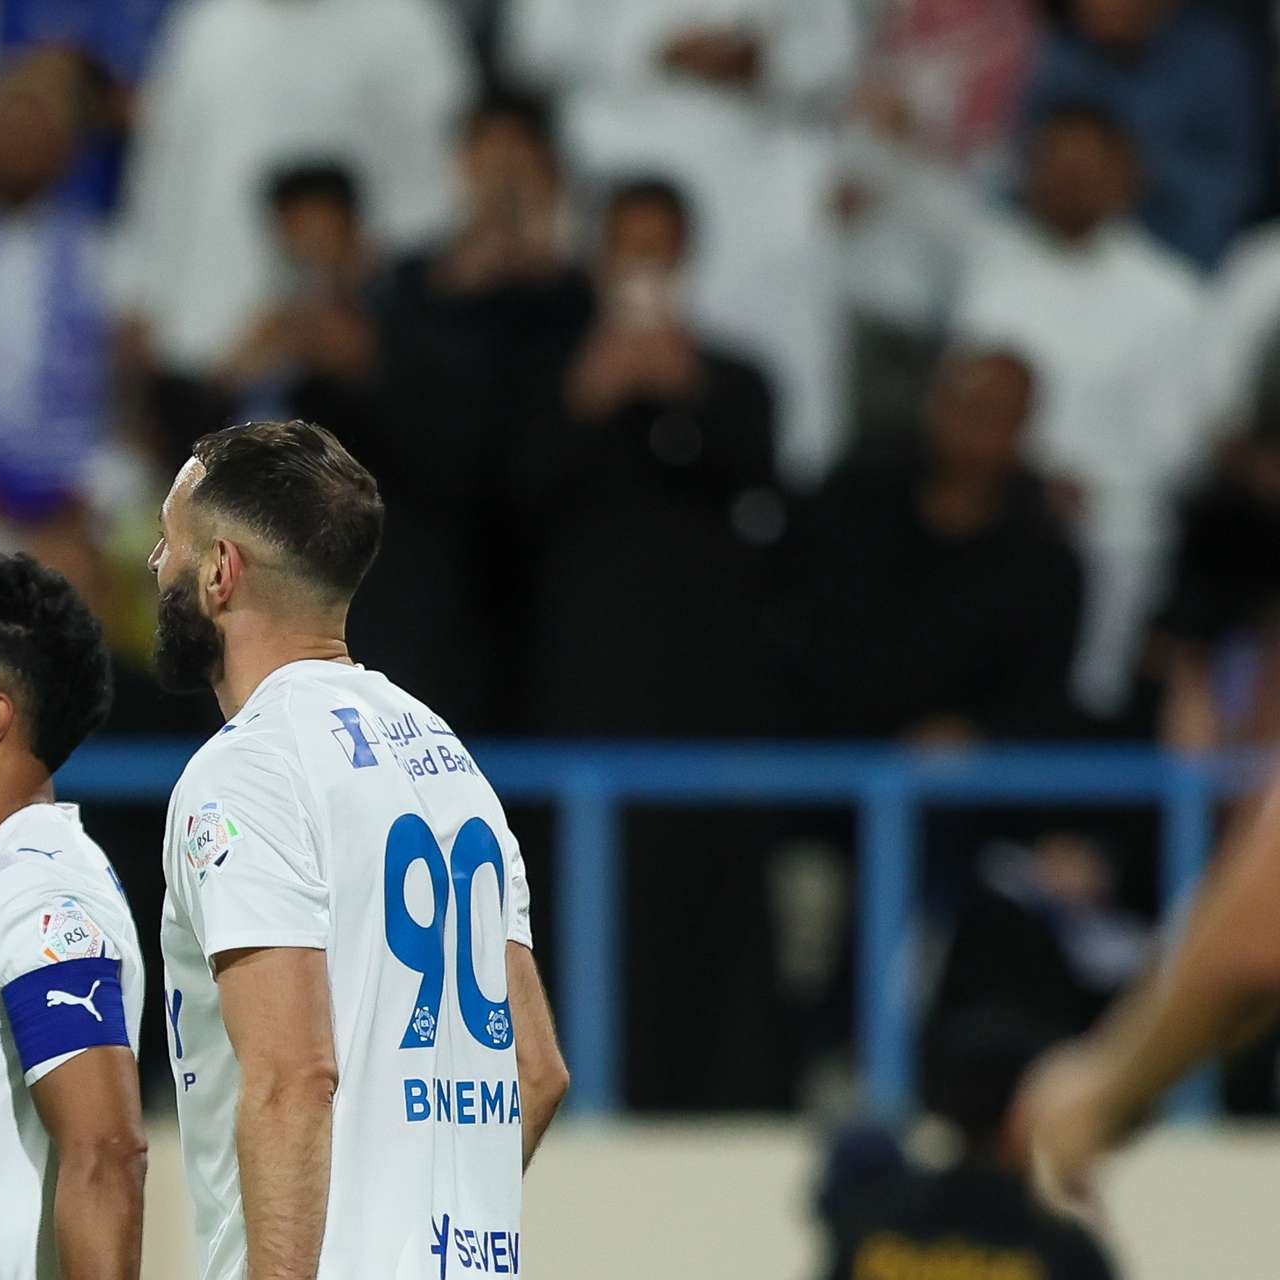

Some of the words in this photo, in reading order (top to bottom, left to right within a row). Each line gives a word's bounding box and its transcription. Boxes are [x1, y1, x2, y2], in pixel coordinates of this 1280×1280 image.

[63, 926, 90, 946] RSL
[384, 813, 515, 1051] 90
[403, 1077, 522, 1125] BNEMA
[453, 1227, 520, 1275] SEVEN
